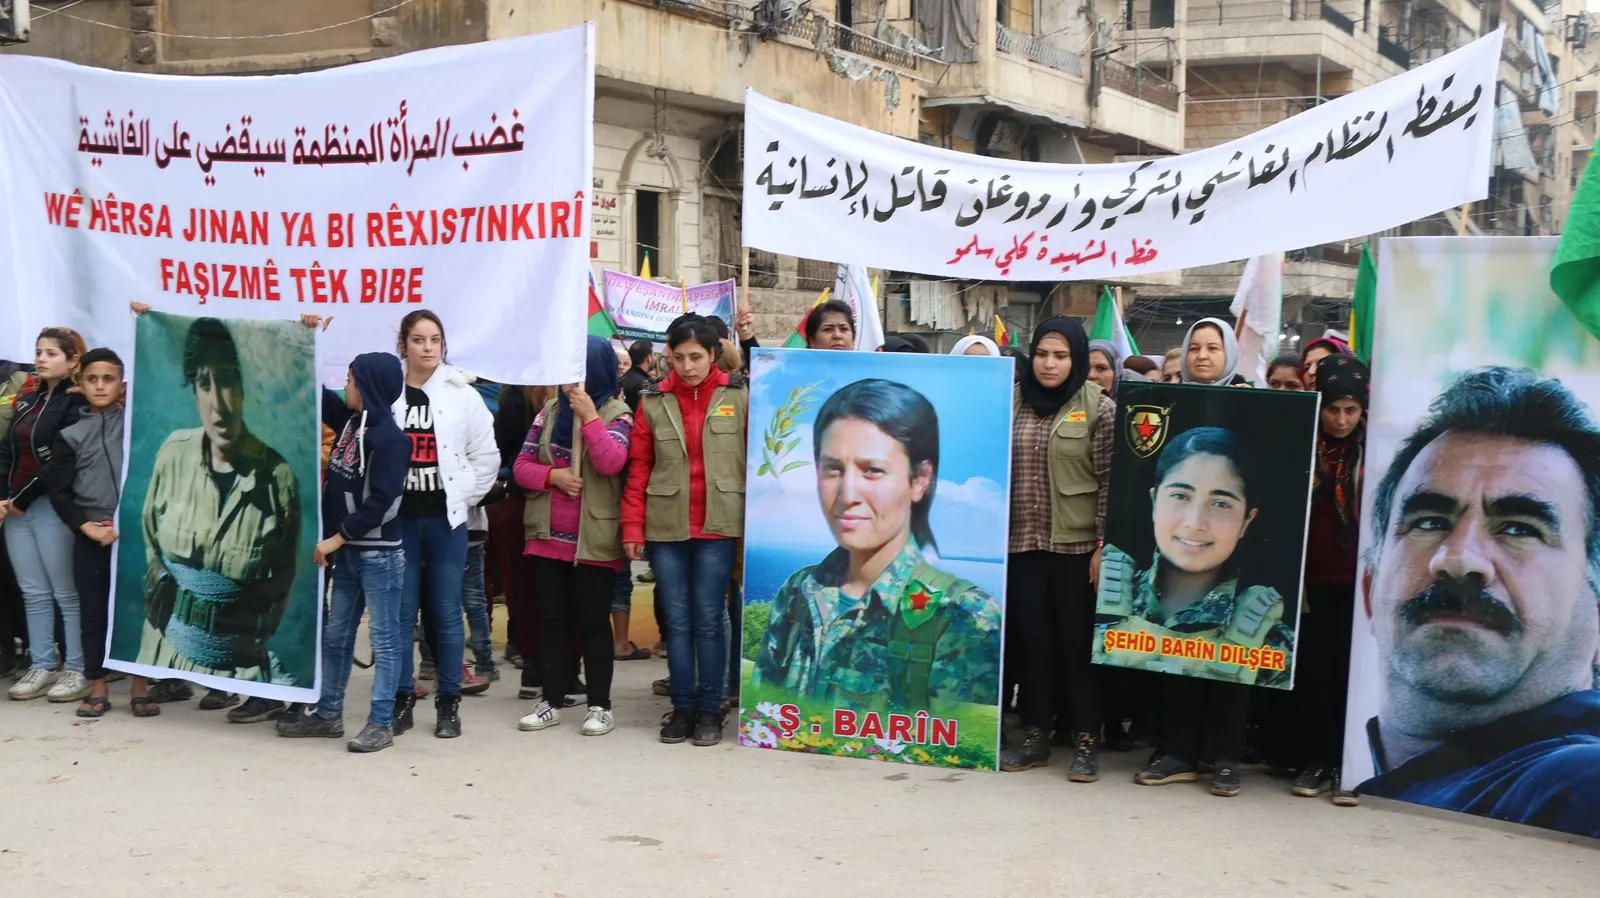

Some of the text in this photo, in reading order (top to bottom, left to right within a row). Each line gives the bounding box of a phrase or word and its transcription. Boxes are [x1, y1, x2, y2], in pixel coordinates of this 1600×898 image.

[1401, 72, 1482, 139] يسقط
[78, 100, 525, 186] غضب المرأة المنظمة سيقضي على الفاشية
[1303, 110, 1394, 190] النظام
[756, 140, 868, 219] الإنسانية
[873, 166, 950, 222] قاتل
[1100, 161, 1181, 230] التركي
[1185, 144, 1297, 225] الفاشي
[45, 188, 585, 248] WÊ HÊRSA JINAN YA BI RÊXISTINKIRÎ
[160, 258, 424, 305] FAŞIZMÊ TÊK BIBE
[1036, 234, 1116, 273] الشهيدة
[1105, 630, 1285, 671] ŞEHÎD BARÎN DILŞÊR
[777, 703, 800, 737] Ş
[833, 708, 958, 747] BARÎN
